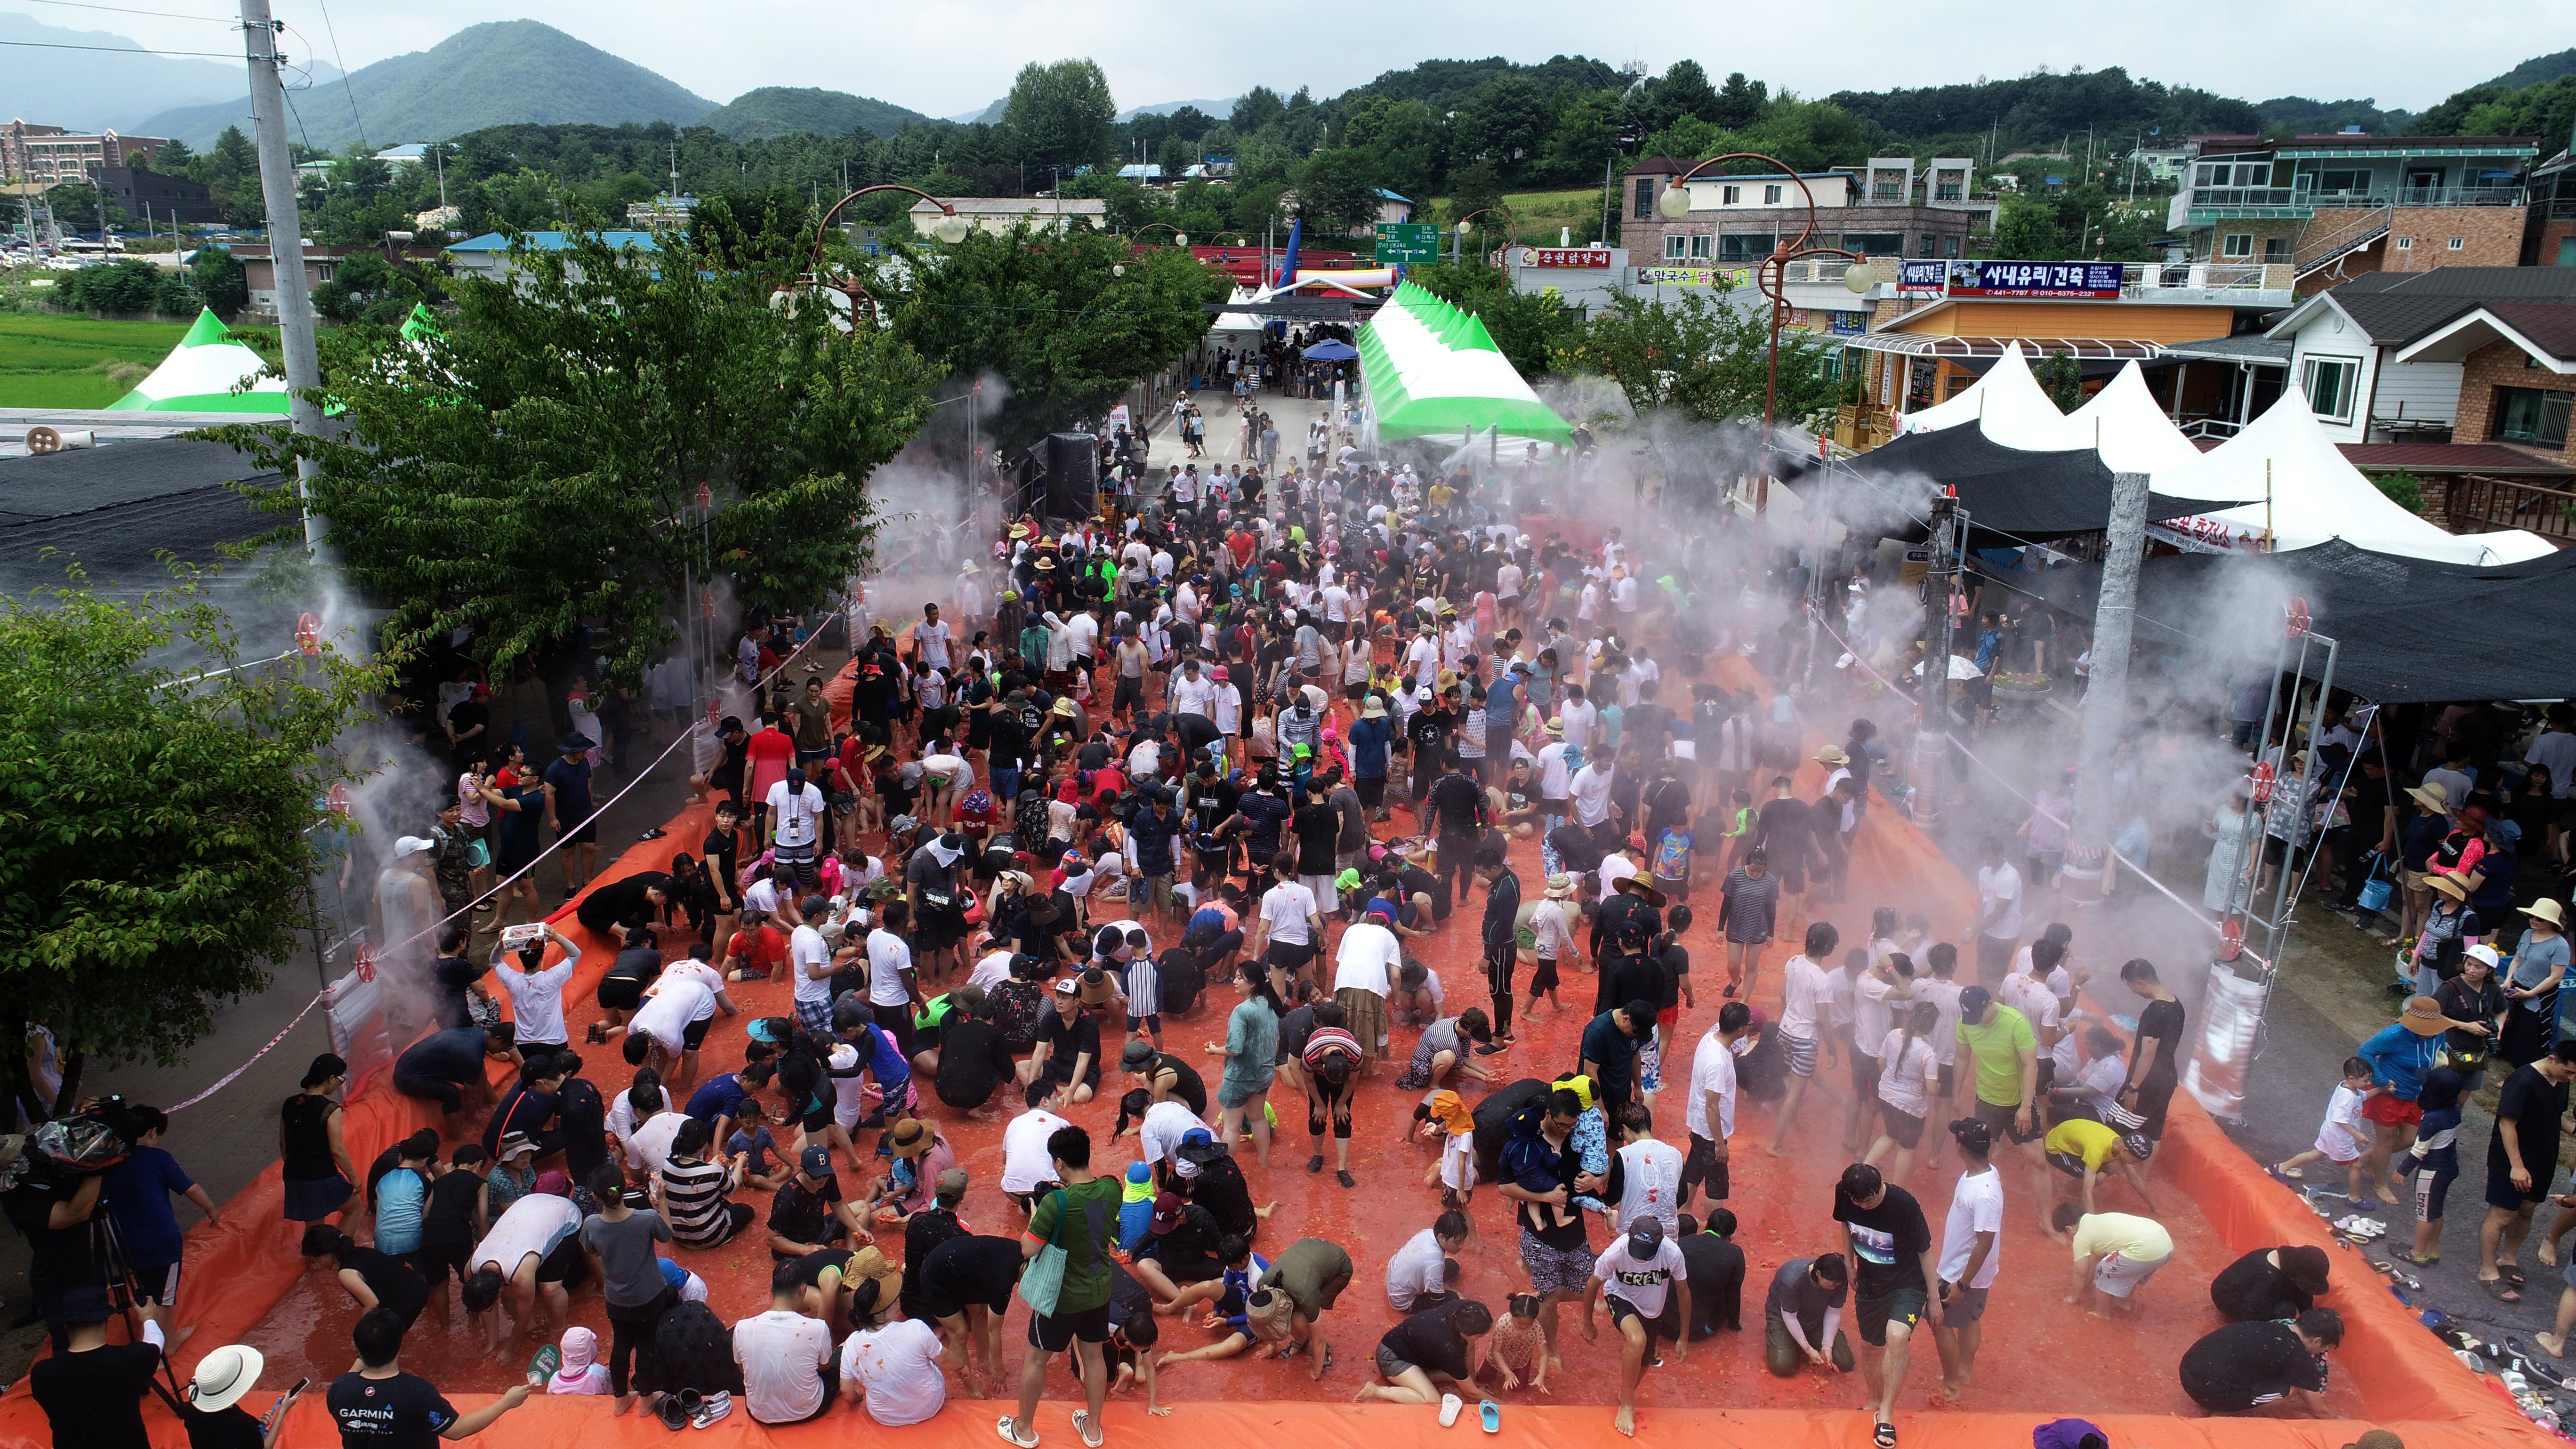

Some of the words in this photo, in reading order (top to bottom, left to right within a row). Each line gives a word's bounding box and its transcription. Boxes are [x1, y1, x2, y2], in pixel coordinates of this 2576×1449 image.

[1540, 252, 1607, 264] 춘천닭갈비
[1906, 265, 1935, 282] 사내유리/건축
[1985, 266, 2084, 287] 사내유리/건축
[2192, 517, 2232, 550] 충전소
[818, 1153, 826, 1166] B
[2417, 1192, 2426, 1216] crocs
[1156, 1211, 1166, 1221] N
[1623, 1271, 1662, 1286] CREW
[339, 1408, 394, 1420] GARMIN
